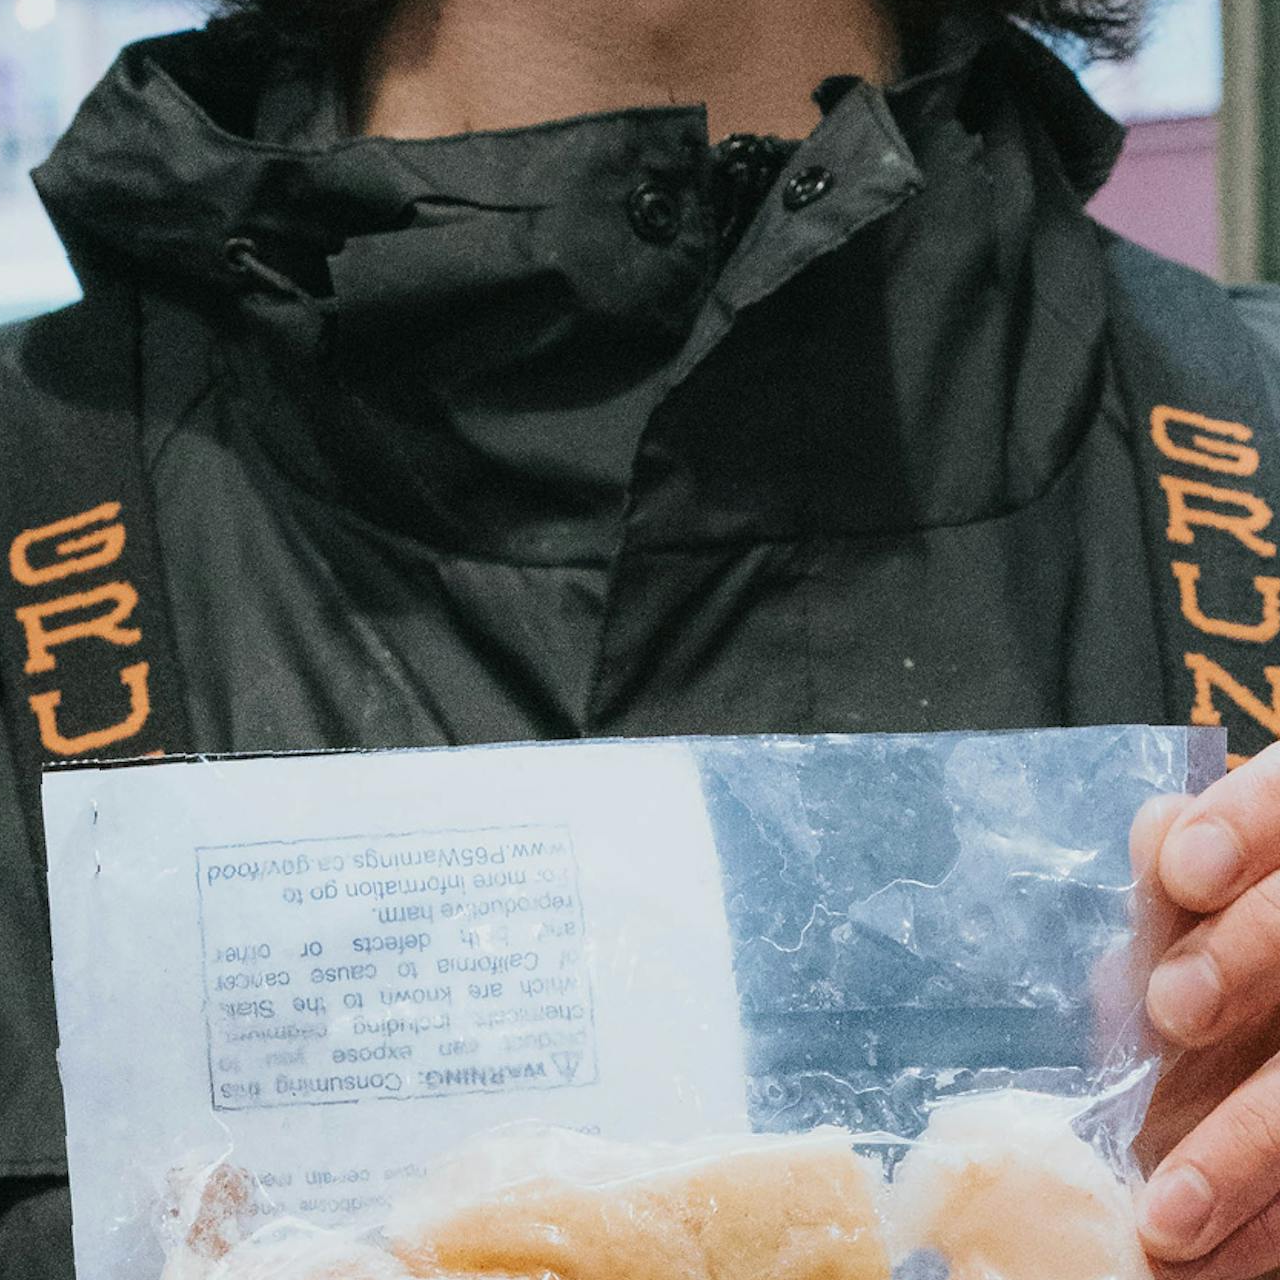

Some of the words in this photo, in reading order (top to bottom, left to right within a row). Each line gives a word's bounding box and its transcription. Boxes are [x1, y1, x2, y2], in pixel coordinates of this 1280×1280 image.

[8, 501, 166, 757] GRU
[346, 874, 466, 901] information
[472, 871, 527, 890] more
[282, 888, 304, 907] to
[310, 882, 339, 901] go
[372, 904, 433, 927] harm.
[440, 893, 574, 921] reproductive
[300, 941, 323, 958] or
[353, 932, 431, 957] defects
[311, 965, 377, 986] cause
[397, 961, 416, 980] to
[437, 951, 539, 979] California
[214, 971, 291, 994] cancer
[468, 981, 502, 999] are
[293, 995, 326, 1015] the
[343, 992, 363, 1010] to
[380, 986, 452, 1007] known
[332, 1040, 412, 1065] expose
[276, 1072, 402, 1096] Consuming
